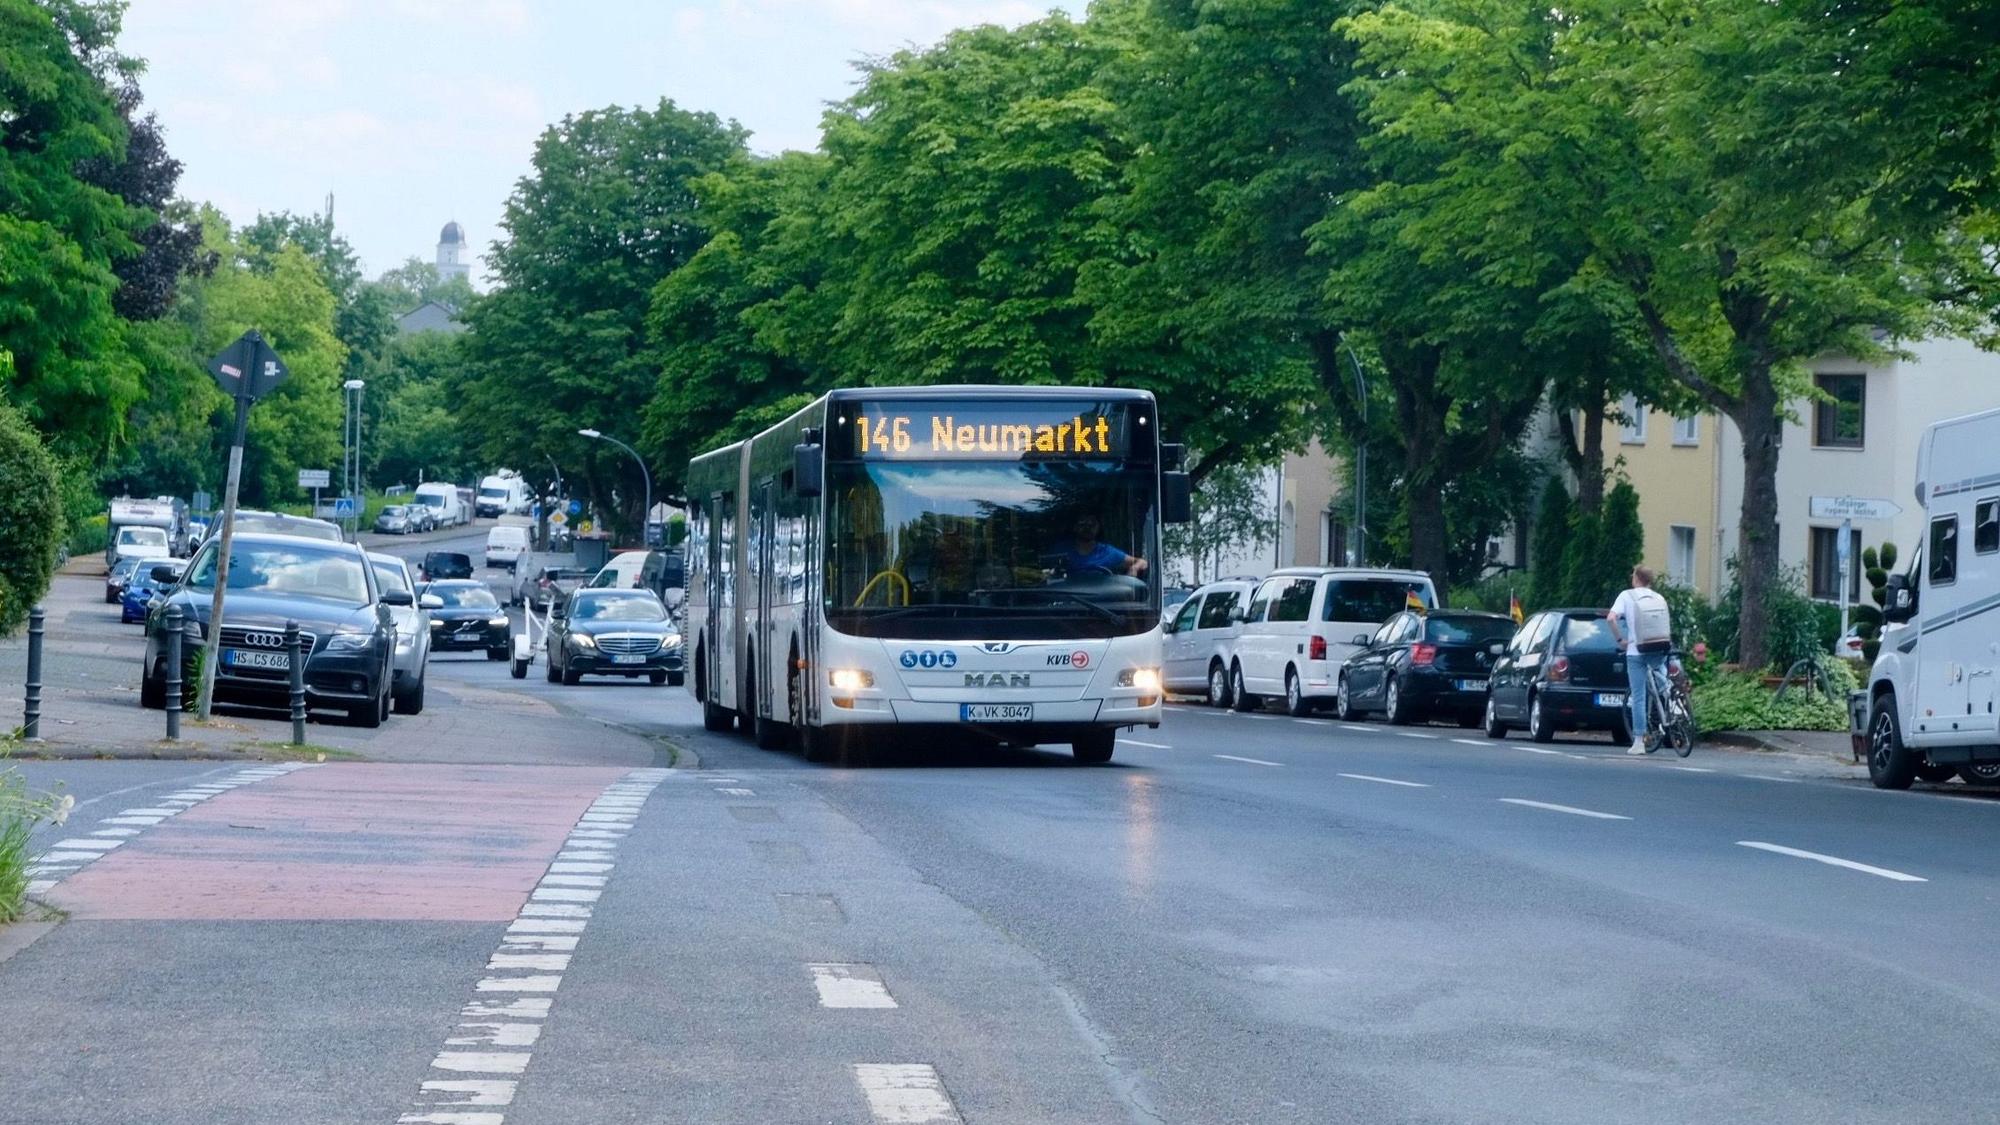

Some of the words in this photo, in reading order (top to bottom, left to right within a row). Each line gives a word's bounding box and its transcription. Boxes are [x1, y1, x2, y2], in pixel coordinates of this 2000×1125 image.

[857, 416, 910, 452] 146
[932, 416, 1109, 453] Neumarkt
[233, 652, 247, 664] HS
[254, 654, 268, 666] CS
[1046, 654, 1071, 665] KVB
[964, 672, 1031, 688] MAN
[968, 706, 976, 718] K
[984, 706, 999, 718] VK
[1001, 706, 1030, 718] 3047
